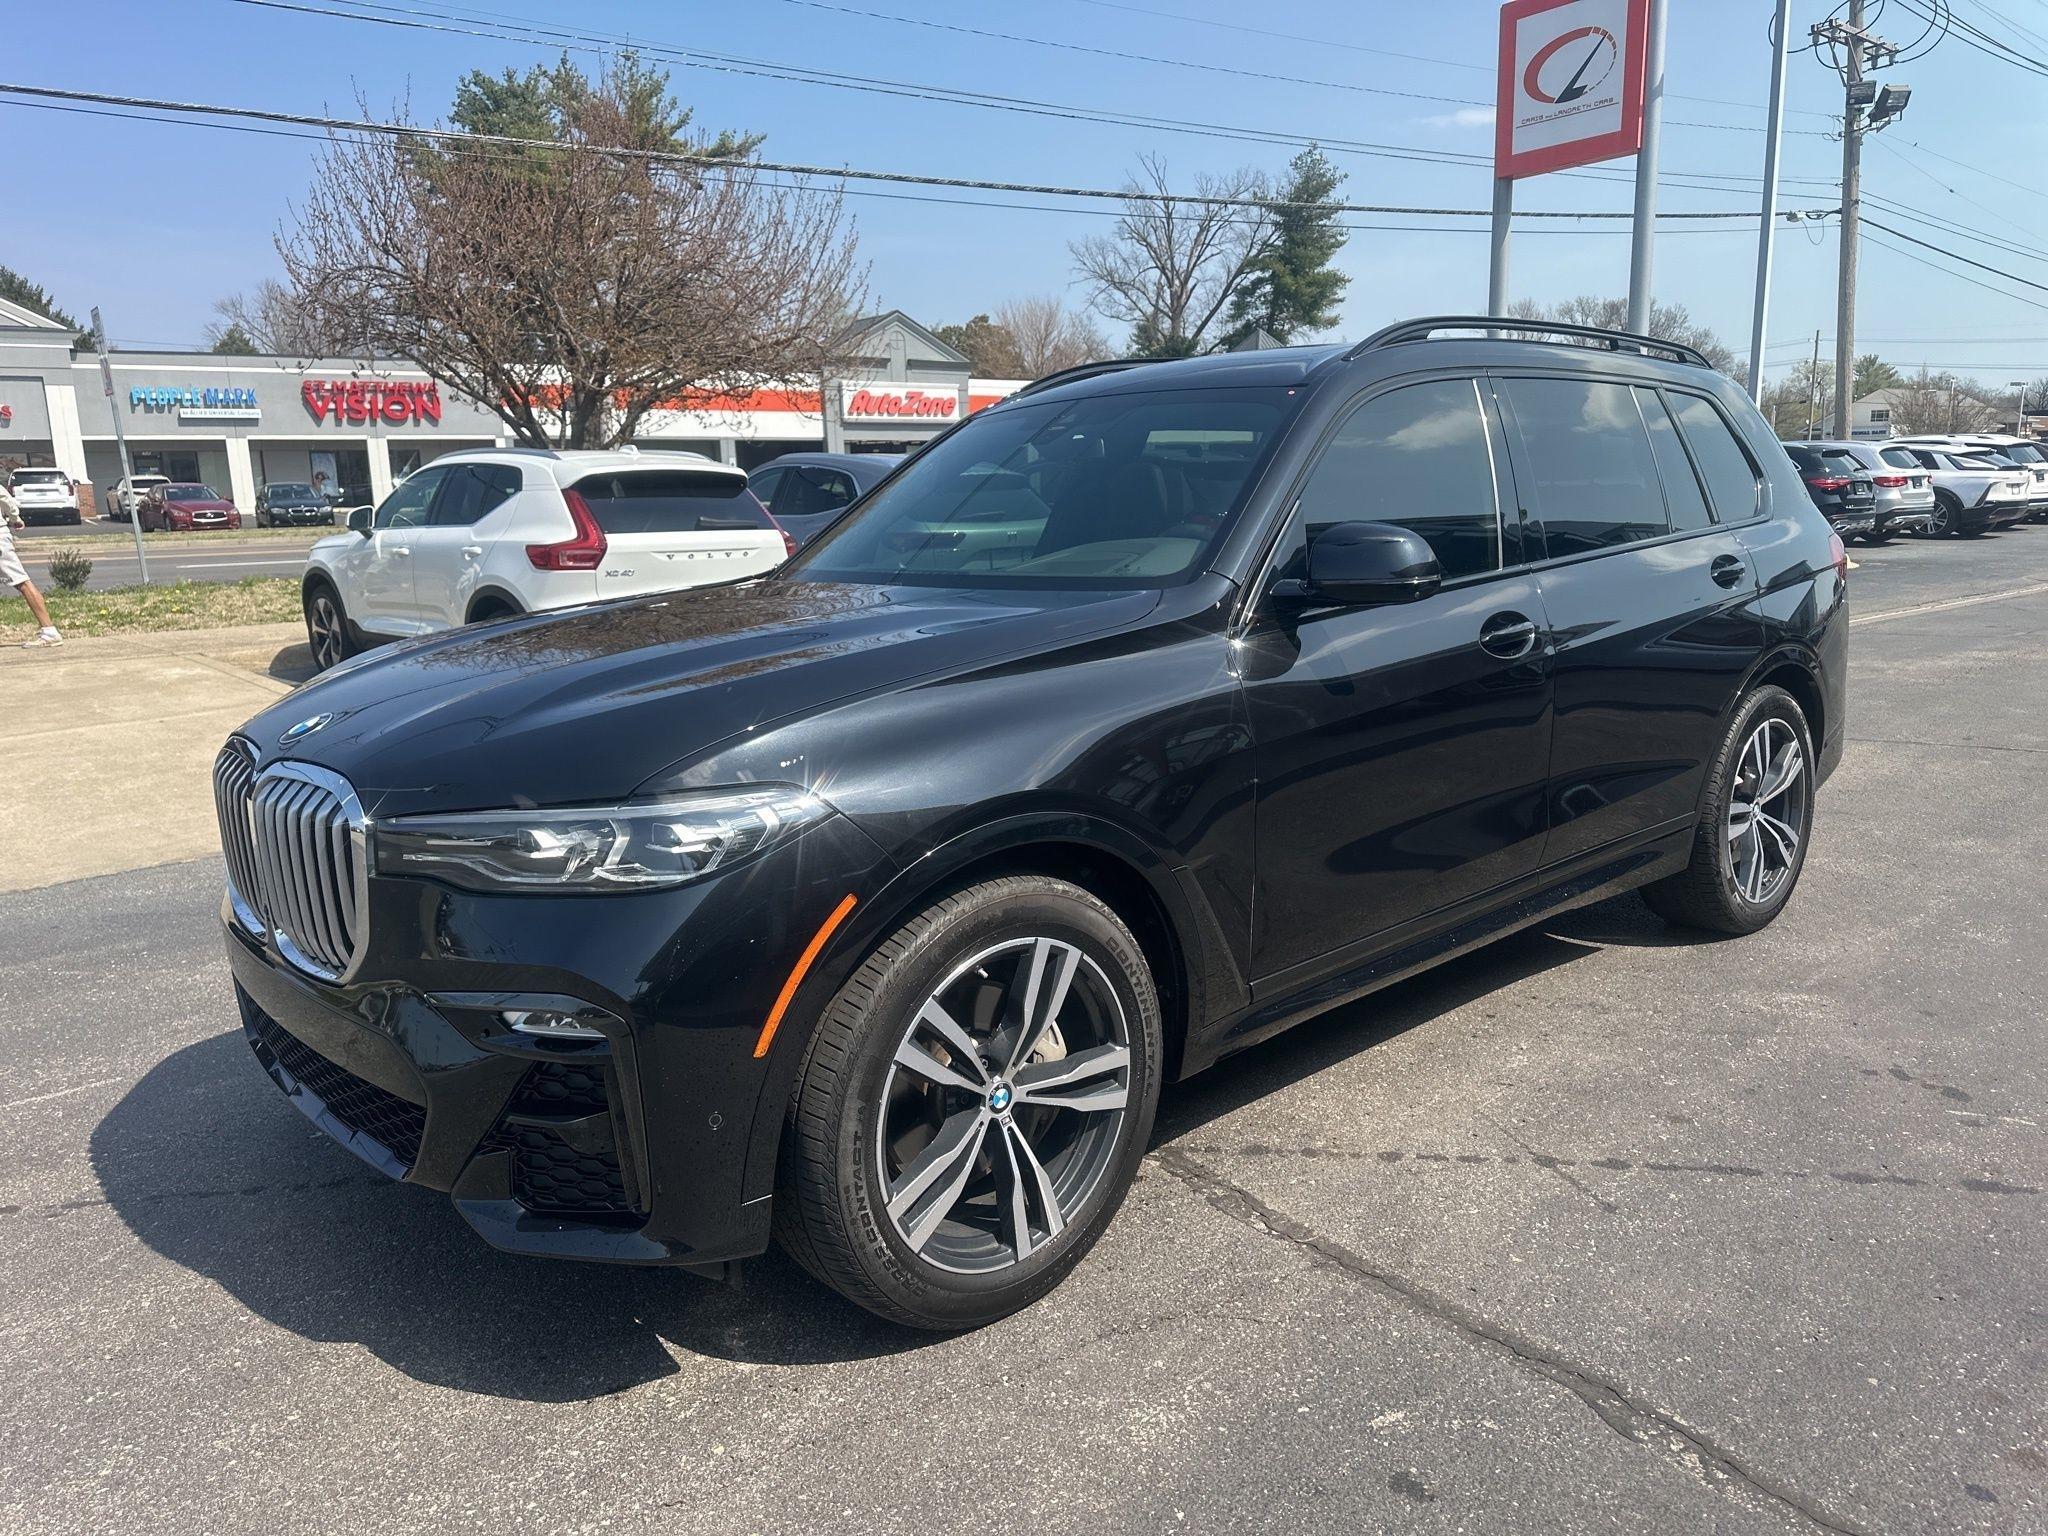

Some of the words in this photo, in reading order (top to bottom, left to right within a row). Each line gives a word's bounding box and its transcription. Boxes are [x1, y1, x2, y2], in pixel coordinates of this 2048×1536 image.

[1594, 97, 1614, 107] CARS
[305, 393, 442, 420] VISION
[847, 389, 957, 417] AutoZone
[666, 550, 749, 561] VOLVO
[1105, 936, 1156, 1094] CONTINENTAL
